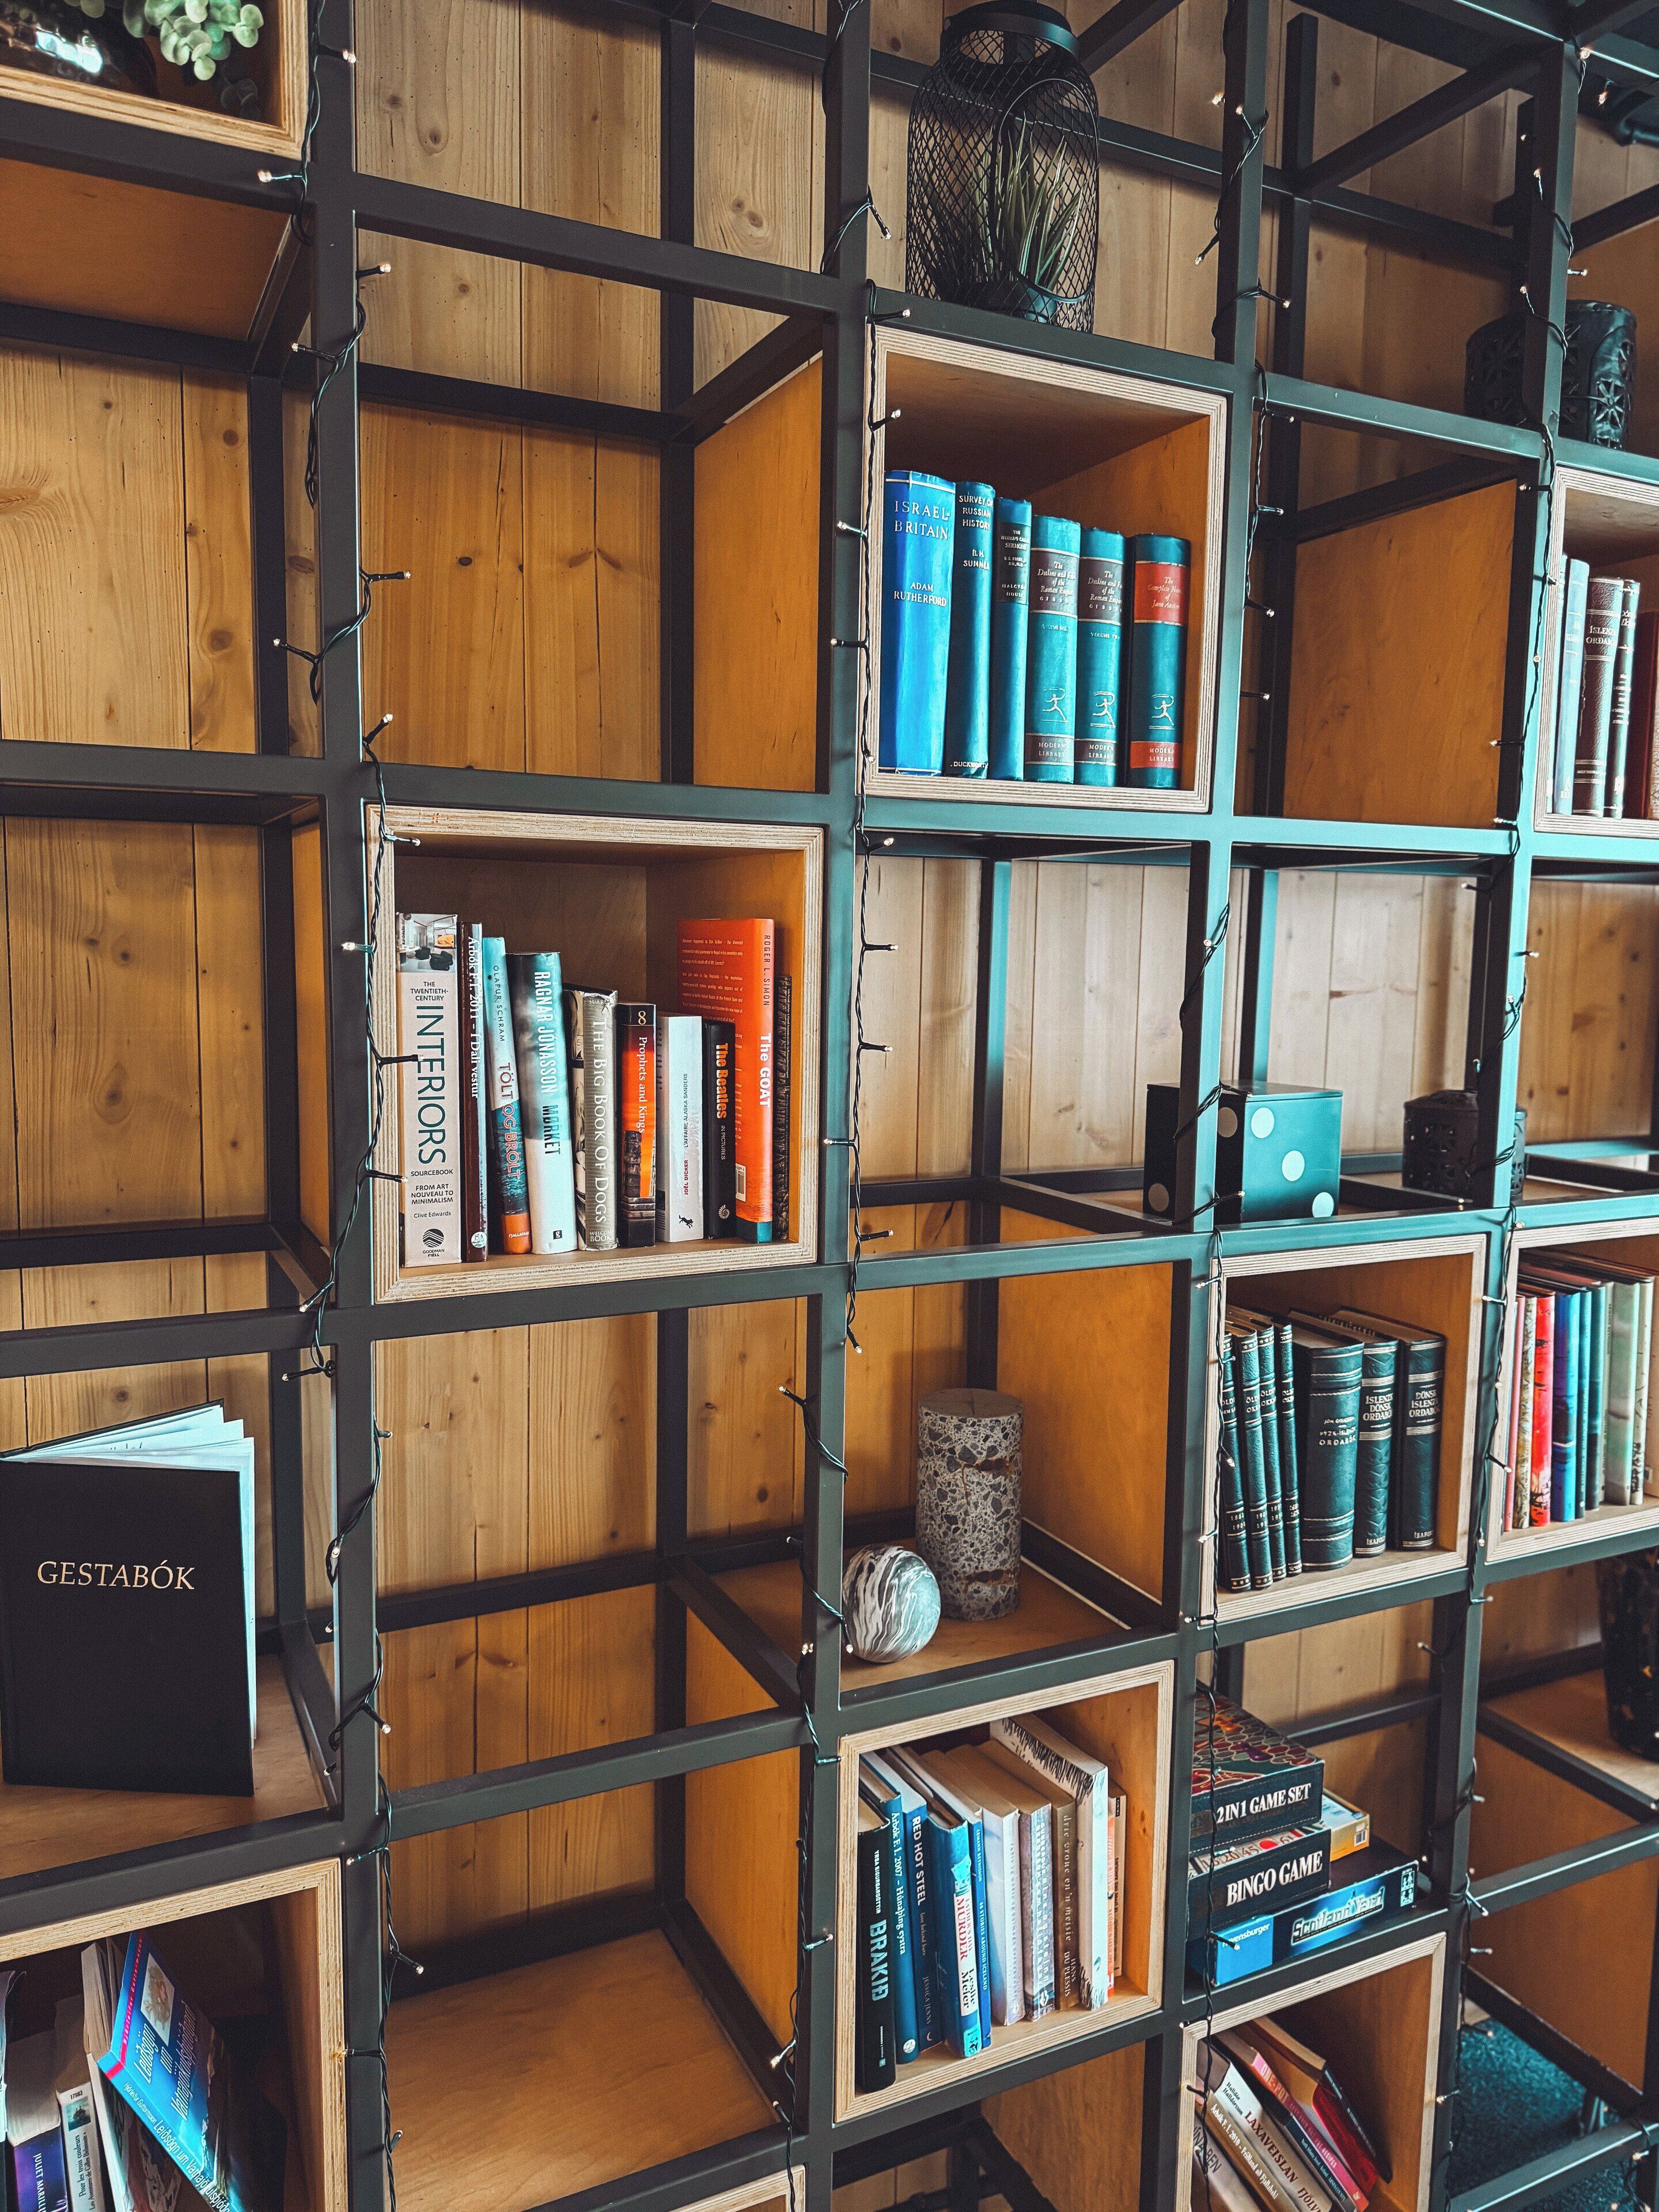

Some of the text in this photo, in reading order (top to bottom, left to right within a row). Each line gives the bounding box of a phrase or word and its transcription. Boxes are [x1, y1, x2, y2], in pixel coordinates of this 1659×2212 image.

[895, 501, 950, 521] ISRAEL-
[959, 495, 986, 506] SURVEY
[963, 507, 991, 518] RUSSIAN
[895, 520, 949, 540] BRITAIN
[963, 519, 990, 531] HISTORY
[1037, 569, 1057, 578] Decline
[1054, 562, 1063, 570] The
[911, 582, 934, 592] ADAM
[1040, 585, 1058, 594] Roman
[1088, 578, 1106, 586] Decline
[1164, 577, 1173, 585] The
[894, 591, 947, 607] RUTHERFORD
[1090, 594, 1108, 602] Roman
[1039, 741, 1066, 749] MODERN
[469, 994, 479, 1019] 2011
[638, 1010, 646, 1025] 8
[497, 1005, 505, 1042] SCHRAM
[534, 971, 558, 1093] RAGNAR JÓNASSON
[716, 1043, 729, 1119] The Beatles
[759, 1033, 771, 1108] The GOAT
[416, 1006, 446, 1164] INTERIORS
[637, 1037, 647, 1134] Prophets and Kings
[499, 1062, 522, 1180] TÖLT OG BRÖLT
[542, 1105, 561, 1154] MØRKET
[593, 1017, 609, 1223] THE BIG BOOK OF DOGS
[411, 1169, 453, 1177] SOURCEBOOK
[411, 1197, 453, 1205] MINIMALISM
[590, 1234, 615, 1243] BOOKS
[37, 1559, 195, 1590] GESTABÓK
[1249, 1790, 1286, 1814] GAME
[1287, 1783, 1311, 1805] SET
[912, 1815, 926, 1907] RED HOT STEEL
[1241, 1846, 1260, 1857] 45
[892, 1813, 906, 1955] Árbók 2007 Húnaþing eystra
[1065, 1878, 1070, 1890] en
[1226, 1850, 1323, 1907] BINGO GAME
[957, 1897, 968, 1961] MURDER
[1065, 1906, 1073, 1941] meisie
[1221, 1923, 1270, 1948] vensburger
[870, 1919, 888, 2001] BRAKIÐ
[1064, 1951, 1070, 1964] DU
[961, 1971, 970, 2009] Meier
[134, 2022, 158, 2084] Leiðsögn
[160, 2046, 173, 2074] um
[1222, 2087, 1243, 2116] Halldórsson
[1226, 2082, 1240, 2101] Halldór
[123, 2082, 189, 2165] Hjörleifur Guttormsson Leiðsögn um
[74, 2135, 82, 2158] couleurs
[1244, 2110, 1298, 2183] LAXAVEISLAN
[33, 2153, 44, 2179] JULIET
[1229, 2130, 1240, 2147] 2010
[1241, 2146, 1258, 2171] Friðland
[1259, 2173, 1279, 2200] Fjallabaki
[77, 2183, 86, 2198] Pour
